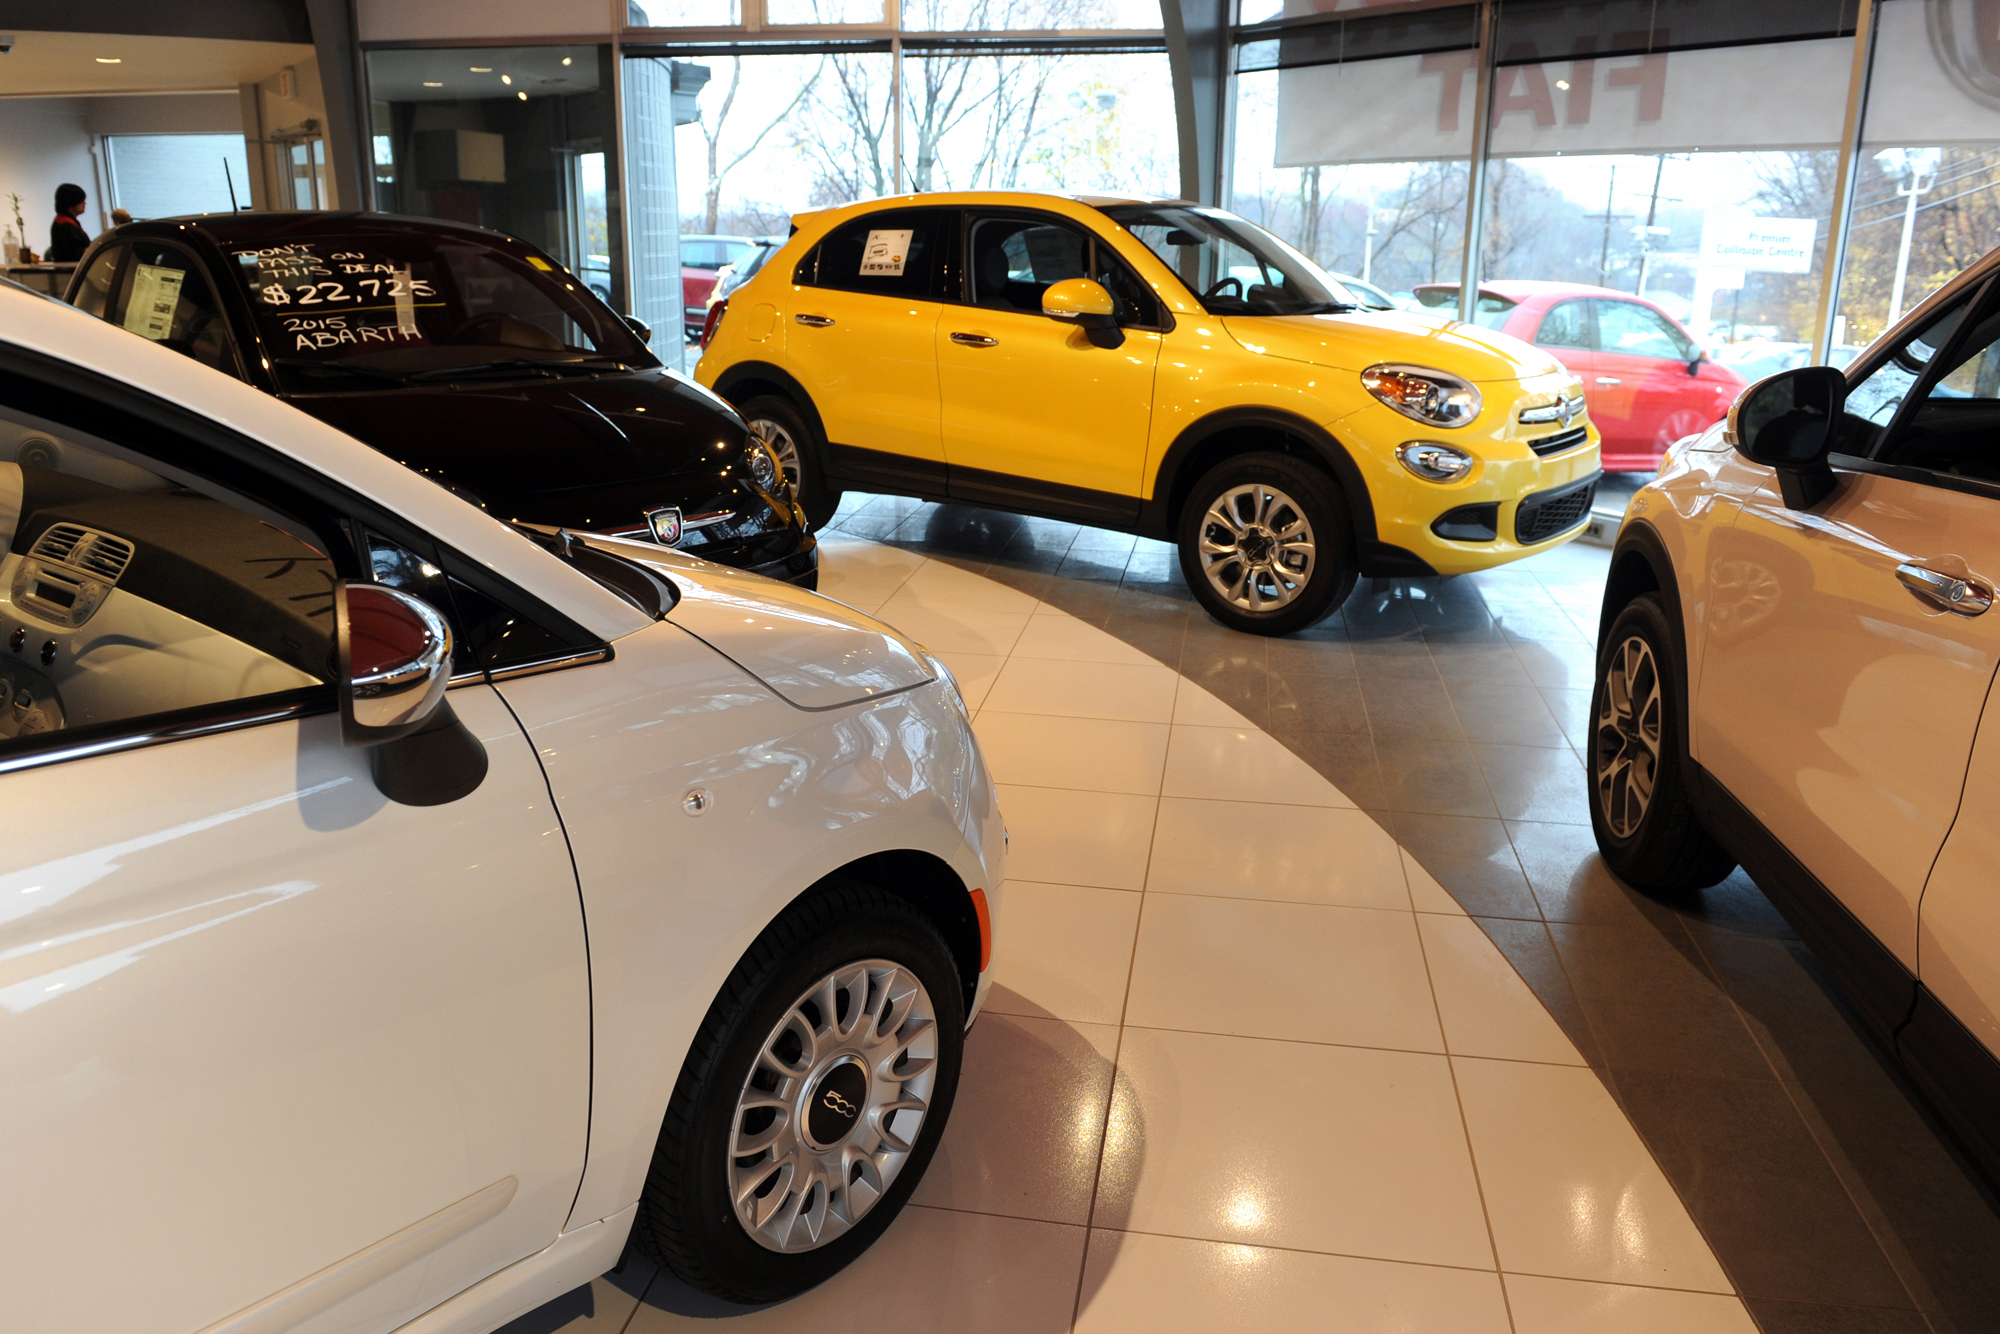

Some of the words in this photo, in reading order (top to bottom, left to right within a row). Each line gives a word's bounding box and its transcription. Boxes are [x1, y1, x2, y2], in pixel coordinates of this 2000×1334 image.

[231, 243, 316, 259] DON'T
[1769, 247, 1804, 257] Centre
[257, 254, 324, 269] PASS
[331, 251, 365, 261] ON
[263, 265, 333, 279] THIS
[339, 263, 409, 275] DEAL
[262, 279, 437, 306] $22,725
[283, 316, 347, 332] 2015
[296, 323, 423, 351] ABARTH
[823, 1090, 856, 1118] 500
